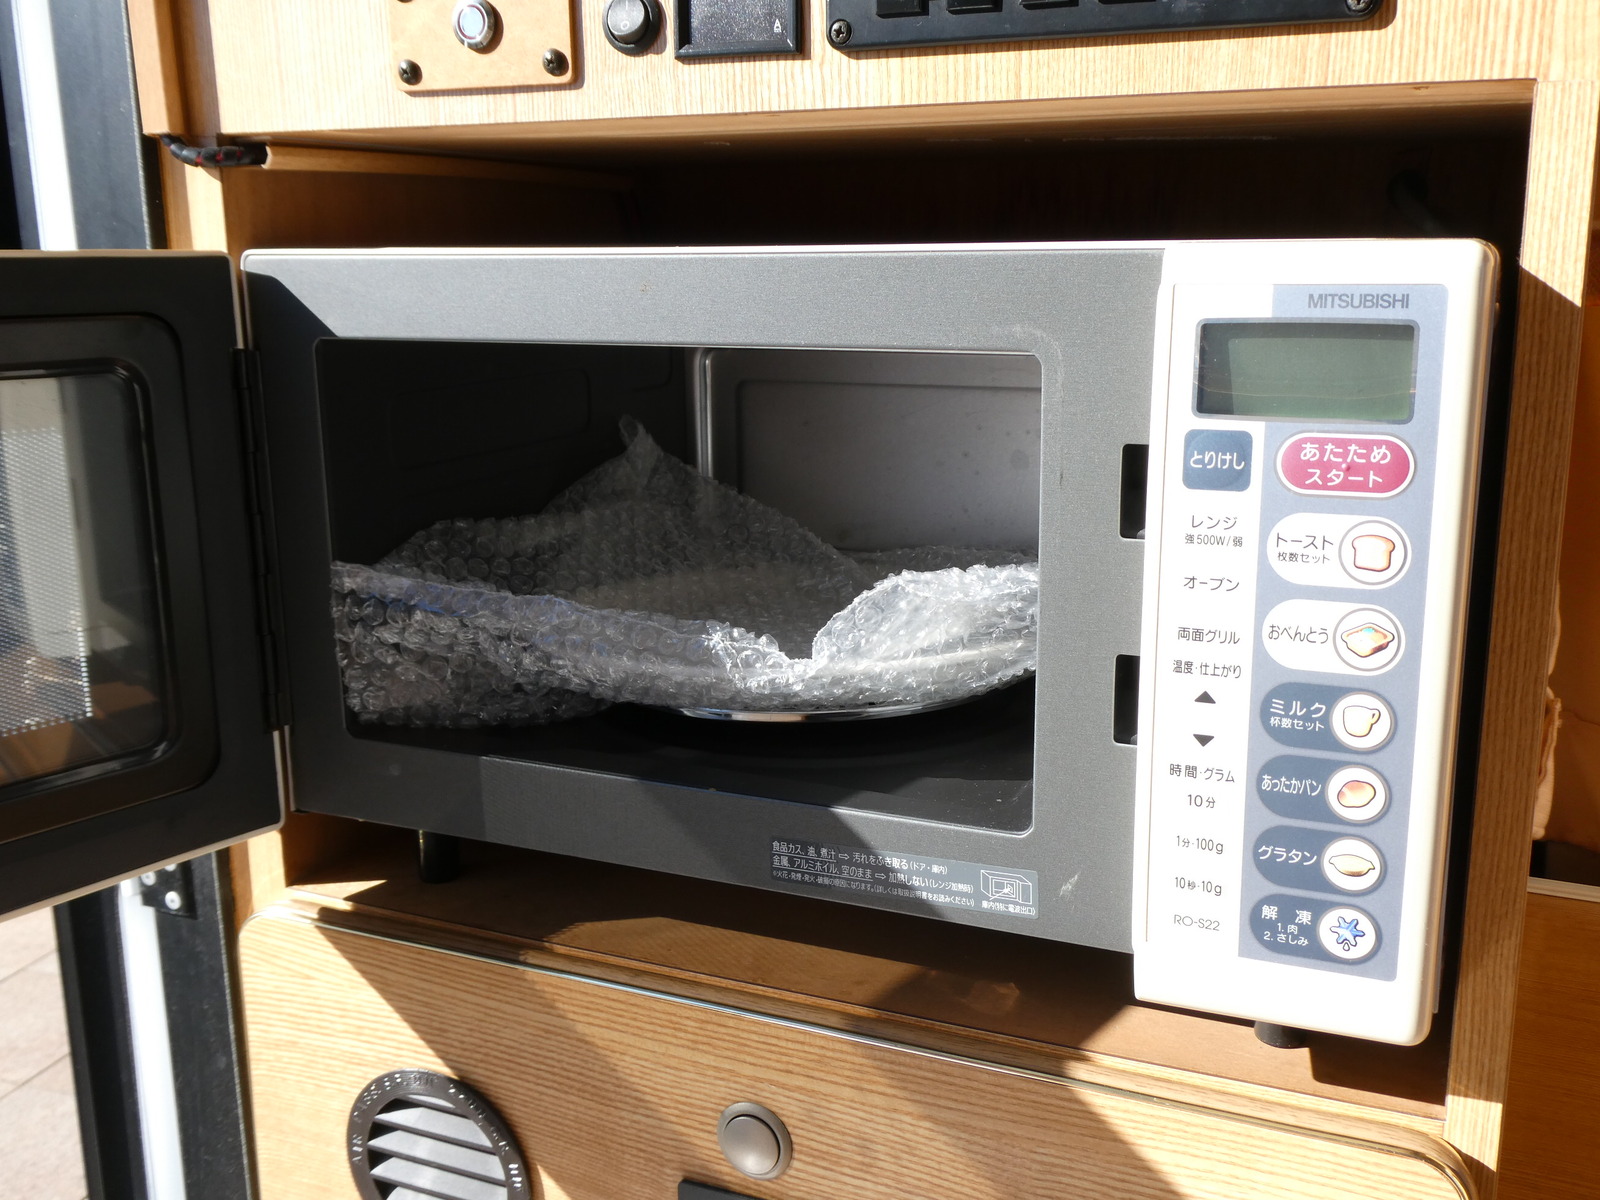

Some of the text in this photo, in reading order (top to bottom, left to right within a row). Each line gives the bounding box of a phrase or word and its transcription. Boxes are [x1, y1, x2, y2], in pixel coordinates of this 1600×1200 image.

[1307, 293, 1410, 309] MITSUBISHI
[1189, 451, 1245, 470] とりけし
[1300, 442, 1391, 465] あたため
[1304, 469, 1383, 489] スタート
[1190, 515, 1238, 531] レンジ
[1276, 532, 1334, 551] トースト
[1277, 552, 1330, 564] 枚数セット
[1183, 576, 1240, 592] オーブン
[1177, 626, 1241, 645] 両面グリル
[1267, 624, 1329, 645] おべんとう
[1269, 698, 1326, 718] ミルク
[1269, 716, 1325, 732] 杯数セット
[1261, 773, 1322, 796] あったかパン
[1186, 794, 1216, 809] 10分
[1257, 844, 1318, 866] グラタン
[1172, 913, 1220, 932] RO-S22
